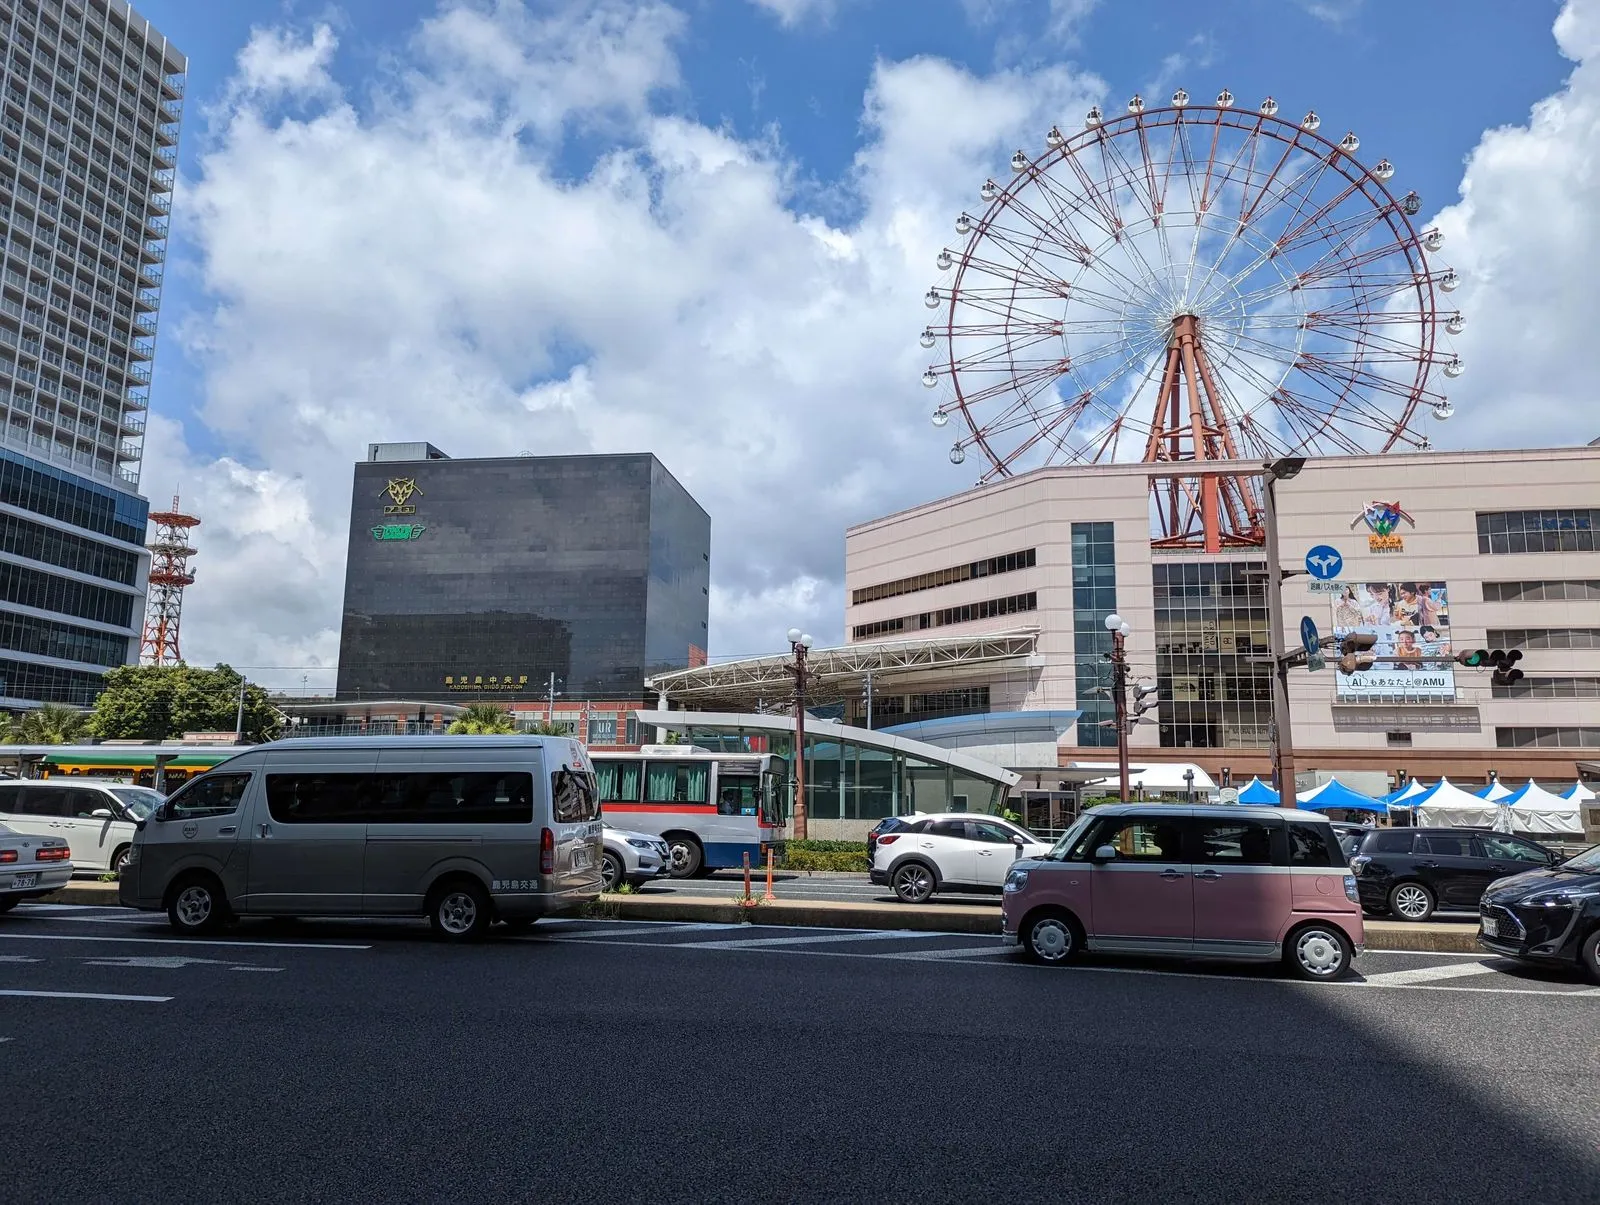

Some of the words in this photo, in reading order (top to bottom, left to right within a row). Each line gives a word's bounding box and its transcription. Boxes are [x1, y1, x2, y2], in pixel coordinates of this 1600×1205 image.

[445, 676, 528, 684] 鹿児島中央駅
[1352, 678, 1362, 686] AI
[598, 722, 612, 733] UR
[492, 879, 538, 890] 鹿児島交通
